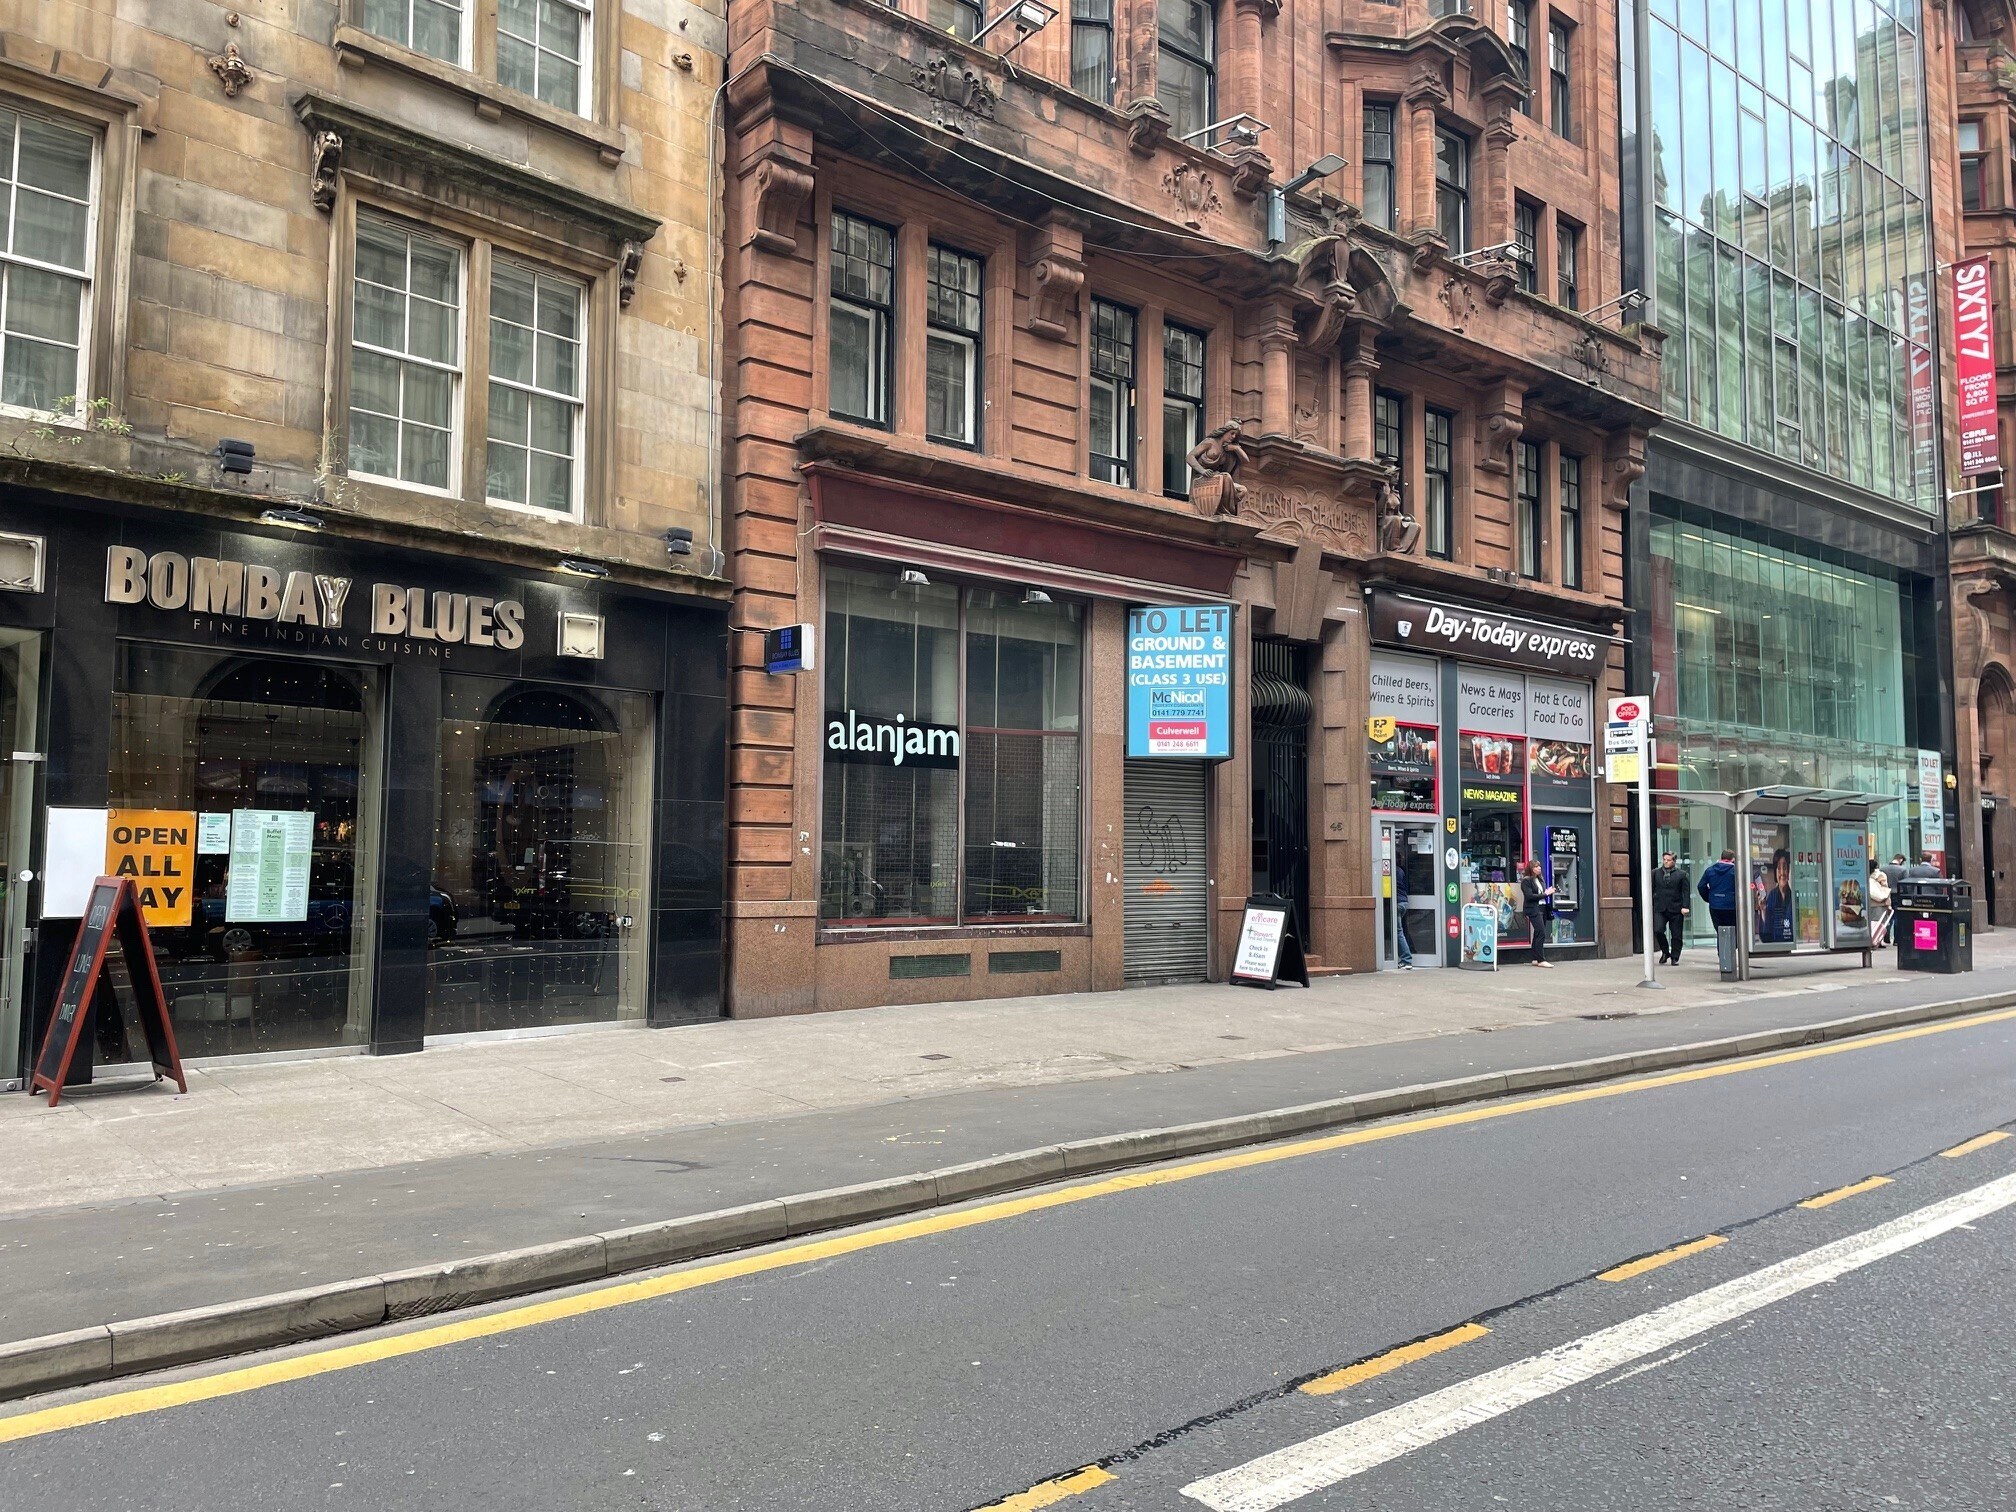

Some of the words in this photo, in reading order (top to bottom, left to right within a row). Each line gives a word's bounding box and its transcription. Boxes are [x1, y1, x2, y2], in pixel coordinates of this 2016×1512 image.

[1956, 264, 1989, 359] SIXTY7
[1960, 372, 1992, 385] FLOORS
[1964, 381, 1989, 391] FROM
[1965, 398, 1978, 406] SQ
[1979, 395, 1989, 403] FT
[1962, 429, 1987, 438] CBRE
[1311, 504, 1368, 538] CHAMBERS
[105, 545, 353, 628] BOMBAY
[371, 583, 525, 650] BLUES
[1131, 610, 1167, 634] TO
[1180, 609, 1227, 632] LET
[193, 618, 249, 636] FINE
[265, 627, 348, 647] INDIAN
[361, 638, 451, 659] CUISINE
[1425, 607, 1527, 653] Day-Today
[1528, 634, 1596, 660] express
[1131, 637, 1205, 651] GROUND
[1212, 636, 1226, 650] &
[1131, 654, 1226, 669] BASEMENT
[1131, 673, 1177, 686] (CLASS
[1183, 674, 1190, 684] 3
[1195, 672, 1227, 685] USE)
[1372, 675, 1403, 687] Chilled
[1405, 678, 1432, 693] Beers,
[1152, 690, 1203, 703] McNicol
[1370, 691, 1395, 704] Wines
[1398, 694, 1404, 704] &
[1407, 694, 1435, 707] Spirits
[1461, 683, 1486, 697] News
[1488, 686, 1495, 698] &
[1498, 687, 1521, 703] Mags
[1534, 691, 1550, 705] Hot
[1553, 694, 1559, 706] &
[1562, 695, 1581, 708] Cold
[1469, 702, 1514, 718] Groceries
[1534, 710, 1555, 723] Food
[1559, 713, 1569, 725] To
[1571, 715, 1583, 726] Go
[828, 709, 959, 766] alanjam
[1157, 727, 1199, 735] Culverwell
[1920, 758, 1928, 767] TO
[1930, 759, 1938, 768] LET
[1464, 789, 1484, 800] NEWS
[1485, 791, 1517, 802] MAGAZINE
[112, 827, 187, 845] OPEN
[115, 855, 182, 877] ALL
[139, 887, 184, 908] AY
